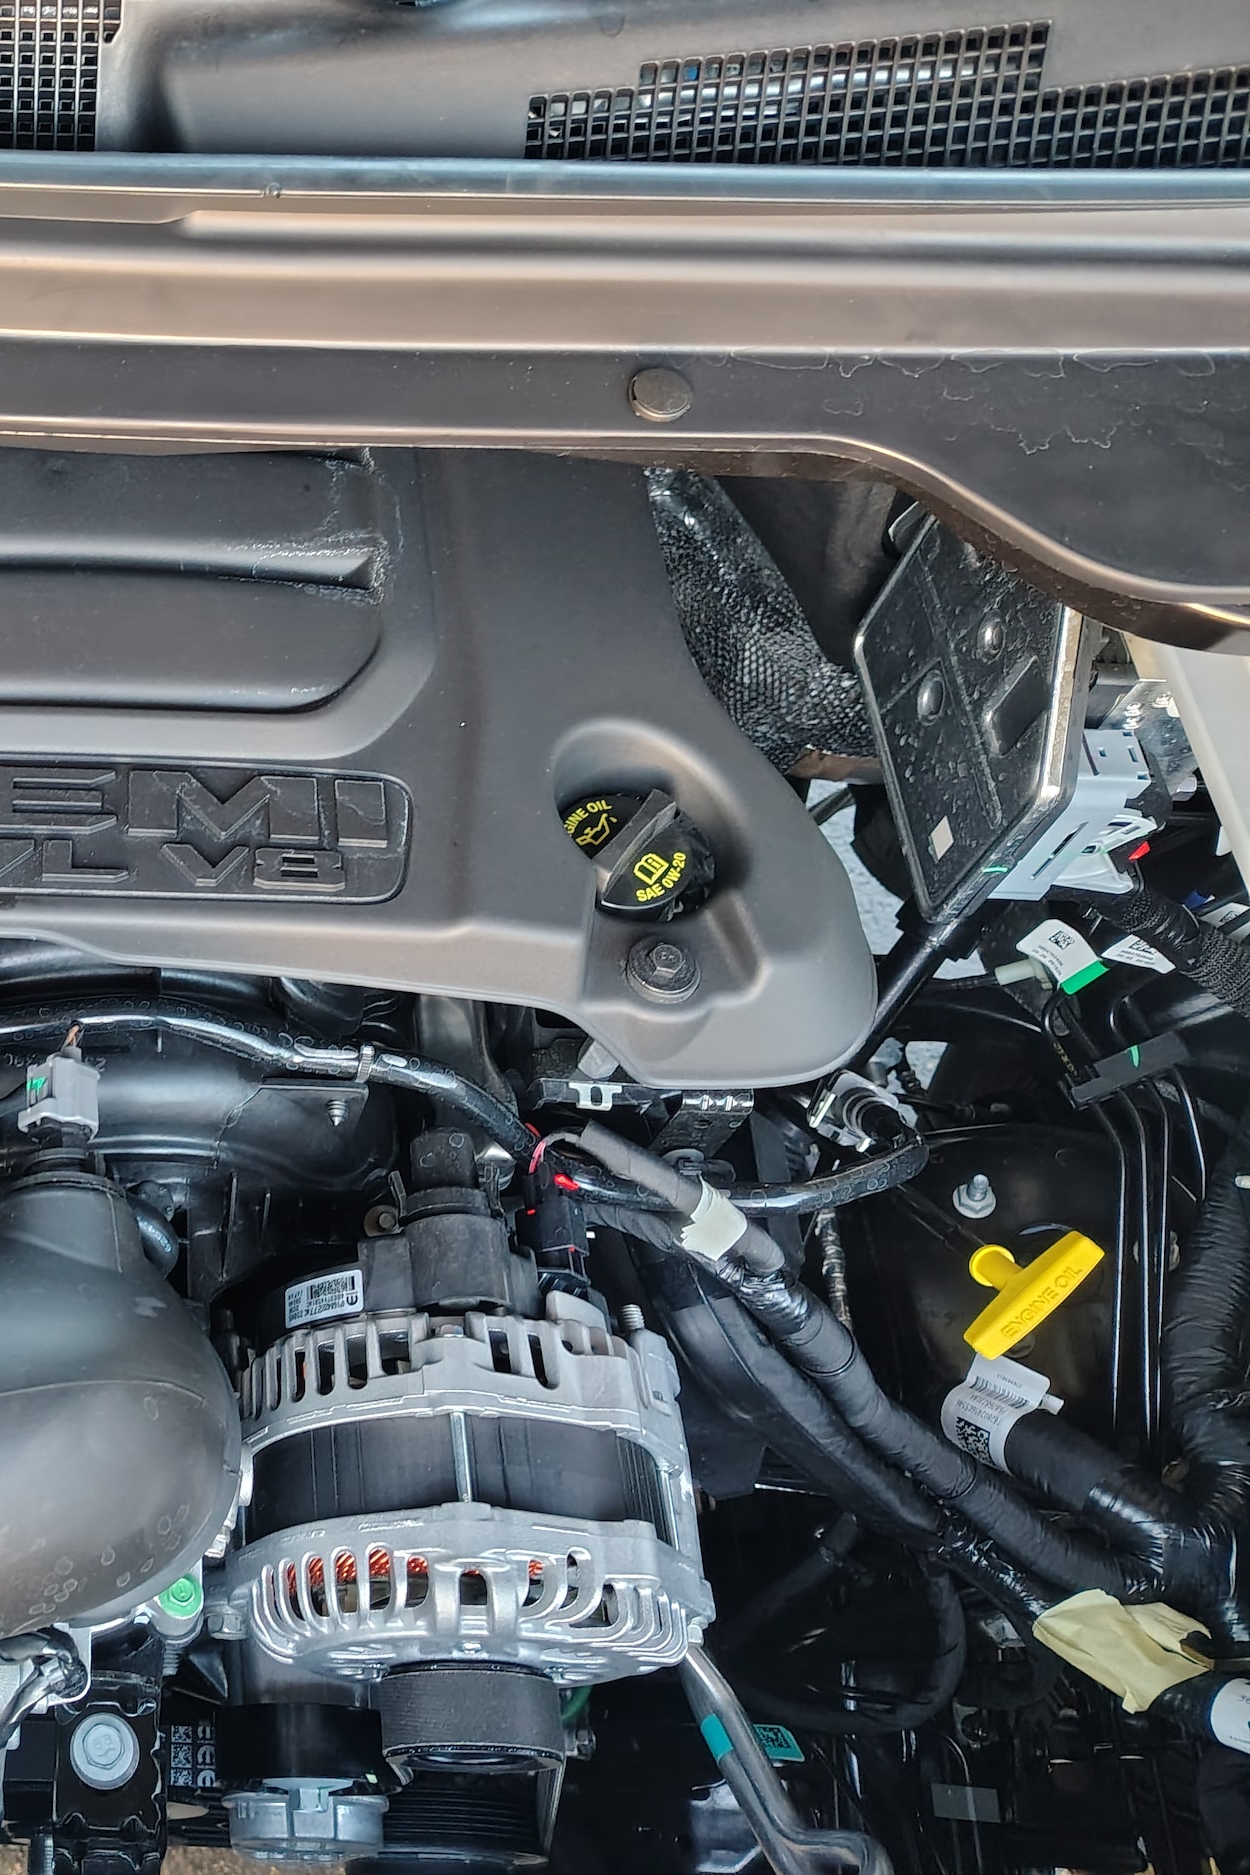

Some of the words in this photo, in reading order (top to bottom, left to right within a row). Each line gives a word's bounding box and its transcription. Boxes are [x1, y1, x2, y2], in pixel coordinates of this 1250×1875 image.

[586, 800, 613, 814] OIL
[159, 841, 346, 890] V8
[635, 882, 665, 902] SAE
[662, 851, 687, 889] 0W-20
[1000, 1286, 1059, 1338] ENGINE
[1054, 1266, 1084, 1290] OIL
